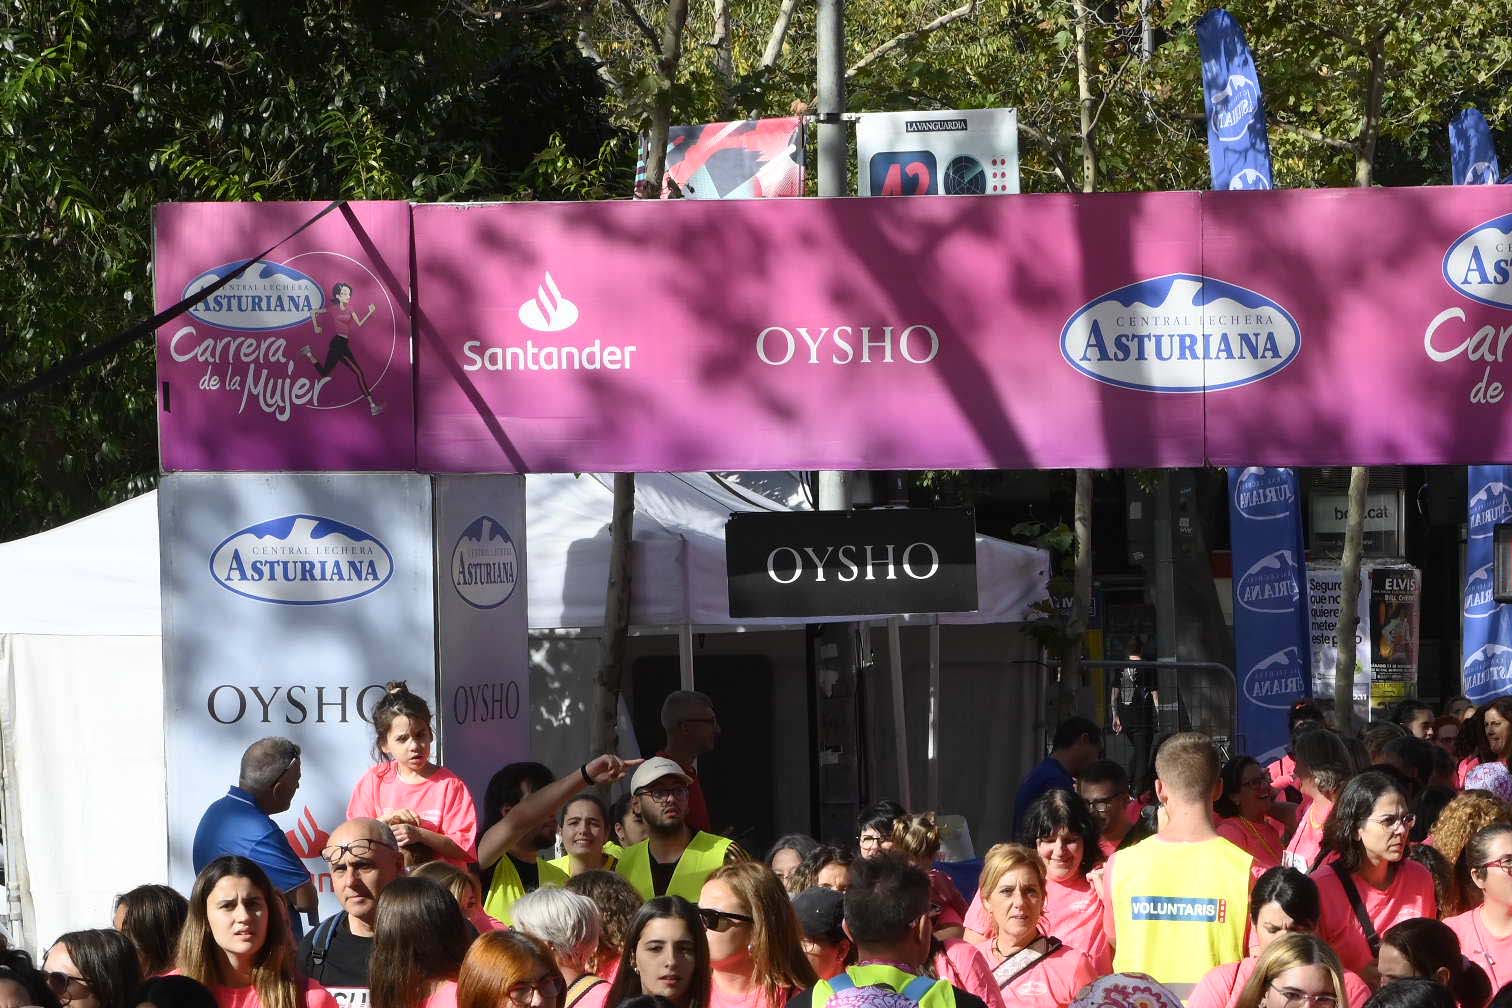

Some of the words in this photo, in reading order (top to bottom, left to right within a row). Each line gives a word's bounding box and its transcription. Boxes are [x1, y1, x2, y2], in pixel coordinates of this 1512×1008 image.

[193, 285, 313, 313] ASTURIANA
[212, 283, 258, 292] ENTRAL
[1115, 315, 1190, 327] CENTRAL
[170, 326, 287, 363] Carrera
[463, 340, 637, 373] Santander
[756, 325, 940, 366] OYSHO
[1080, 319, 1282, 361] ASTURIANA
[198, 366, 221, 390] de
[225, 366, 241, 390] la
[238, 361, 332, 422] Mujer
[1470, 367, 1503, 405] de
[225, 549, 380, 583] ASTURIANA
[252, 546, 310, 556] CENTRAL
[314, 546, 374, 556] LECHERA
[767, 541, 940, 585] OYSHO
[456, 551, 514, 586] ASTURIANA
[1385, 578, 1416, 590] ELVIS
[454, 681, 520, 725] OYSHO
[1132, 902, 1216, 917] VOLUNTARIS
